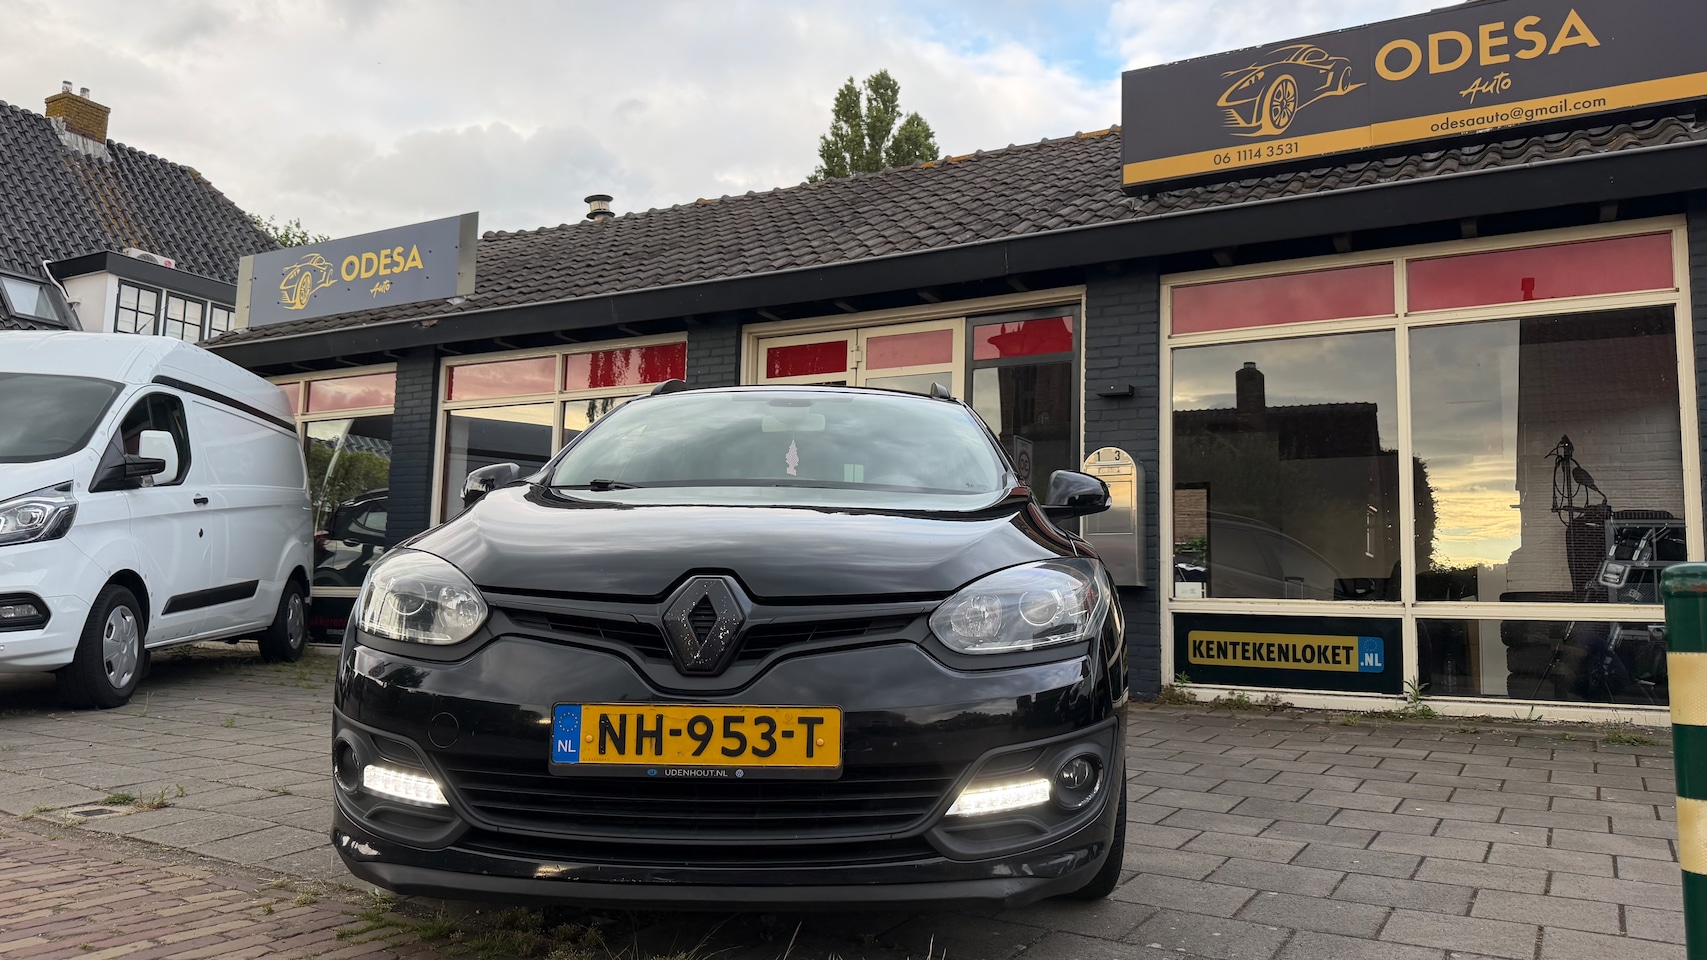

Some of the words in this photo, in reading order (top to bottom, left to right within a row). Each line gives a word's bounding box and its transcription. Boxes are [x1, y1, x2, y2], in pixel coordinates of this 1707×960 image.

[1374, 8, 1601, 81] ODESA
[1459, 72, 1512, 104] Auto
[1430, 96, 1607, 132] odesaauto@gmail.com
[1213, 153, 1231, 165] 06
[1237, 147, 1262, 161] 1114
[1266, 142, 1298, 157] 3531
[341, 244, 424, 282] ODESA
[370, 279, 391, 299] Auto
[557, 740, 576, 753] NL
[598, 713, 824, 758] NH-953-T
[664, 769, 728, 777] UDENHOUT.NL
